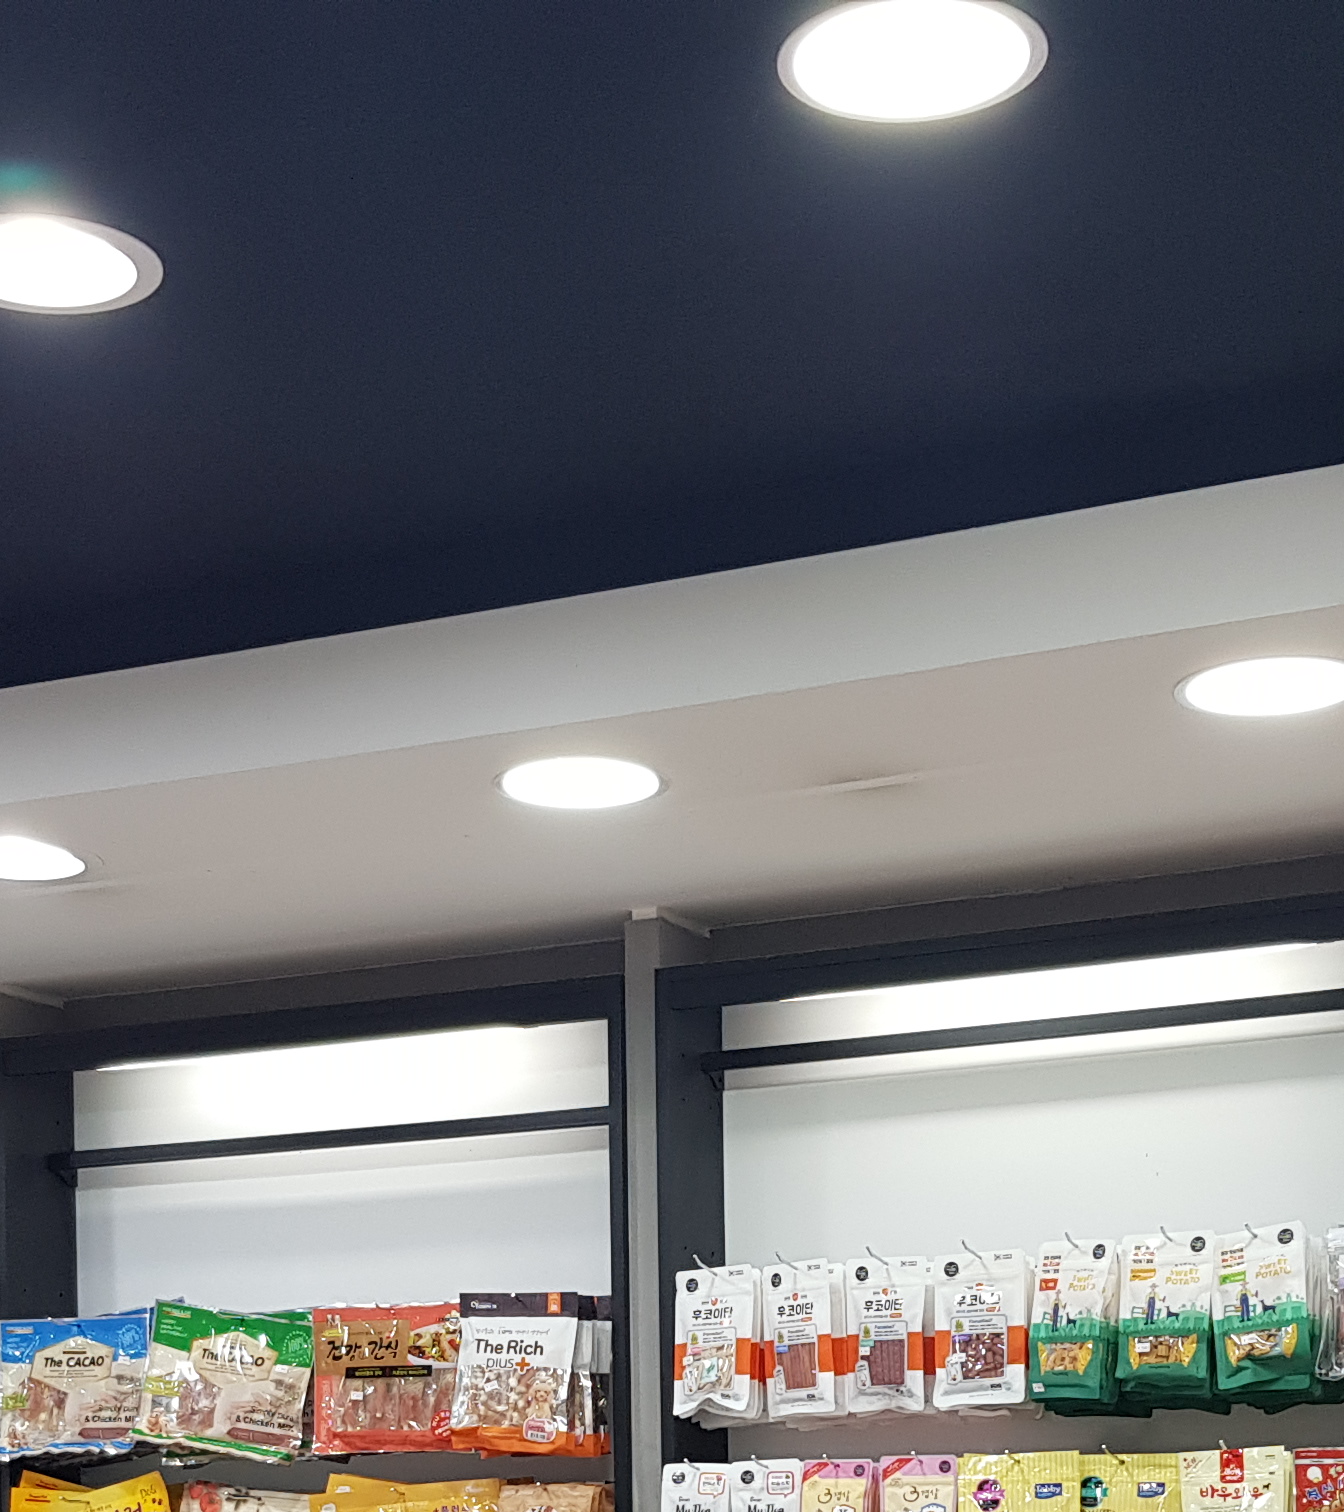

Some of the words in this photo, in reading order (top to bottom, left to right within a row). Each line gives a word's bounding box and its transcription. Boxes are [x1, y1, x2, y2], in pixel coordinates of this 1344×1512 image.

[692, 1306, 733, 1321] 후코이단
[777, 1302, 814, 1318] 후코이단
[475, 1338, 504, 1355] The
[506, 1337, 545, 1356] Rich
[44, 1357, 63, 1368] The
[66, 1356, 105, 1368] CACAO
